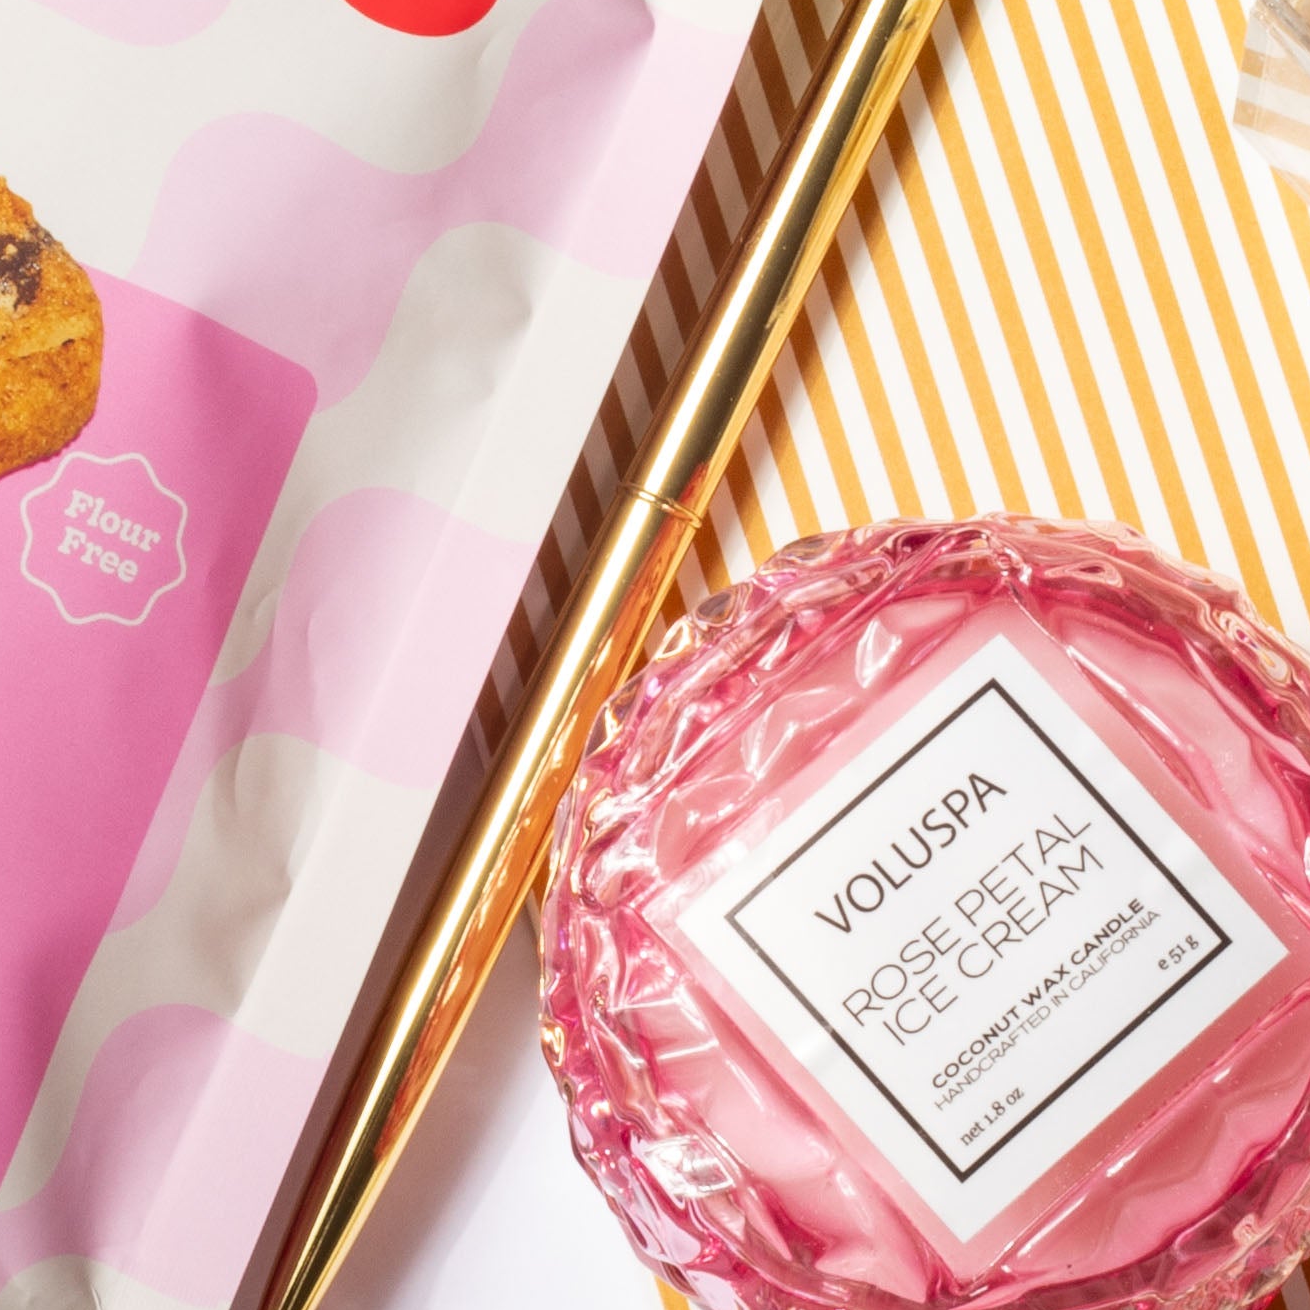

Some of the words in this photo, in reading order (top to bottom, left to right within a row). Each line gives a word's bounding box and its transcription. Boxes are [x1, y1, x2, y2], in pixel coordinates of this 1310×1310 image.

[58, 526, 139, 583] Free
[64, 489, 161, 552] Flour
[814, 772, 1008, 934] VOLUSPA
[842, 916, 962, 1027] ROSE
[954, 813, 1092, 927] PETAL
[883, 974, 959, 1046] ICE
[957, 844, 1104, 979] CREAM
[932, 1005, 1021, 1089] COCONUT
[1021, 963, 1071, 1007] WAX
[1070, 897, 1145, 966] CANDLE
[934, 1005, 1052, 1112] HANDCRAFTED
[1050, 988, 1070, 1008] IN
[1069, 909, 1161, 991] CALIFORNIA
[1168, 944, 1187, 965] 51
[1185, 934, 1199, 950] g
[959, 1122, 985, 1146] net
[983, 1099, 1006, 1125] 1.8
[1005, 1086, 1025, 1106] oz
